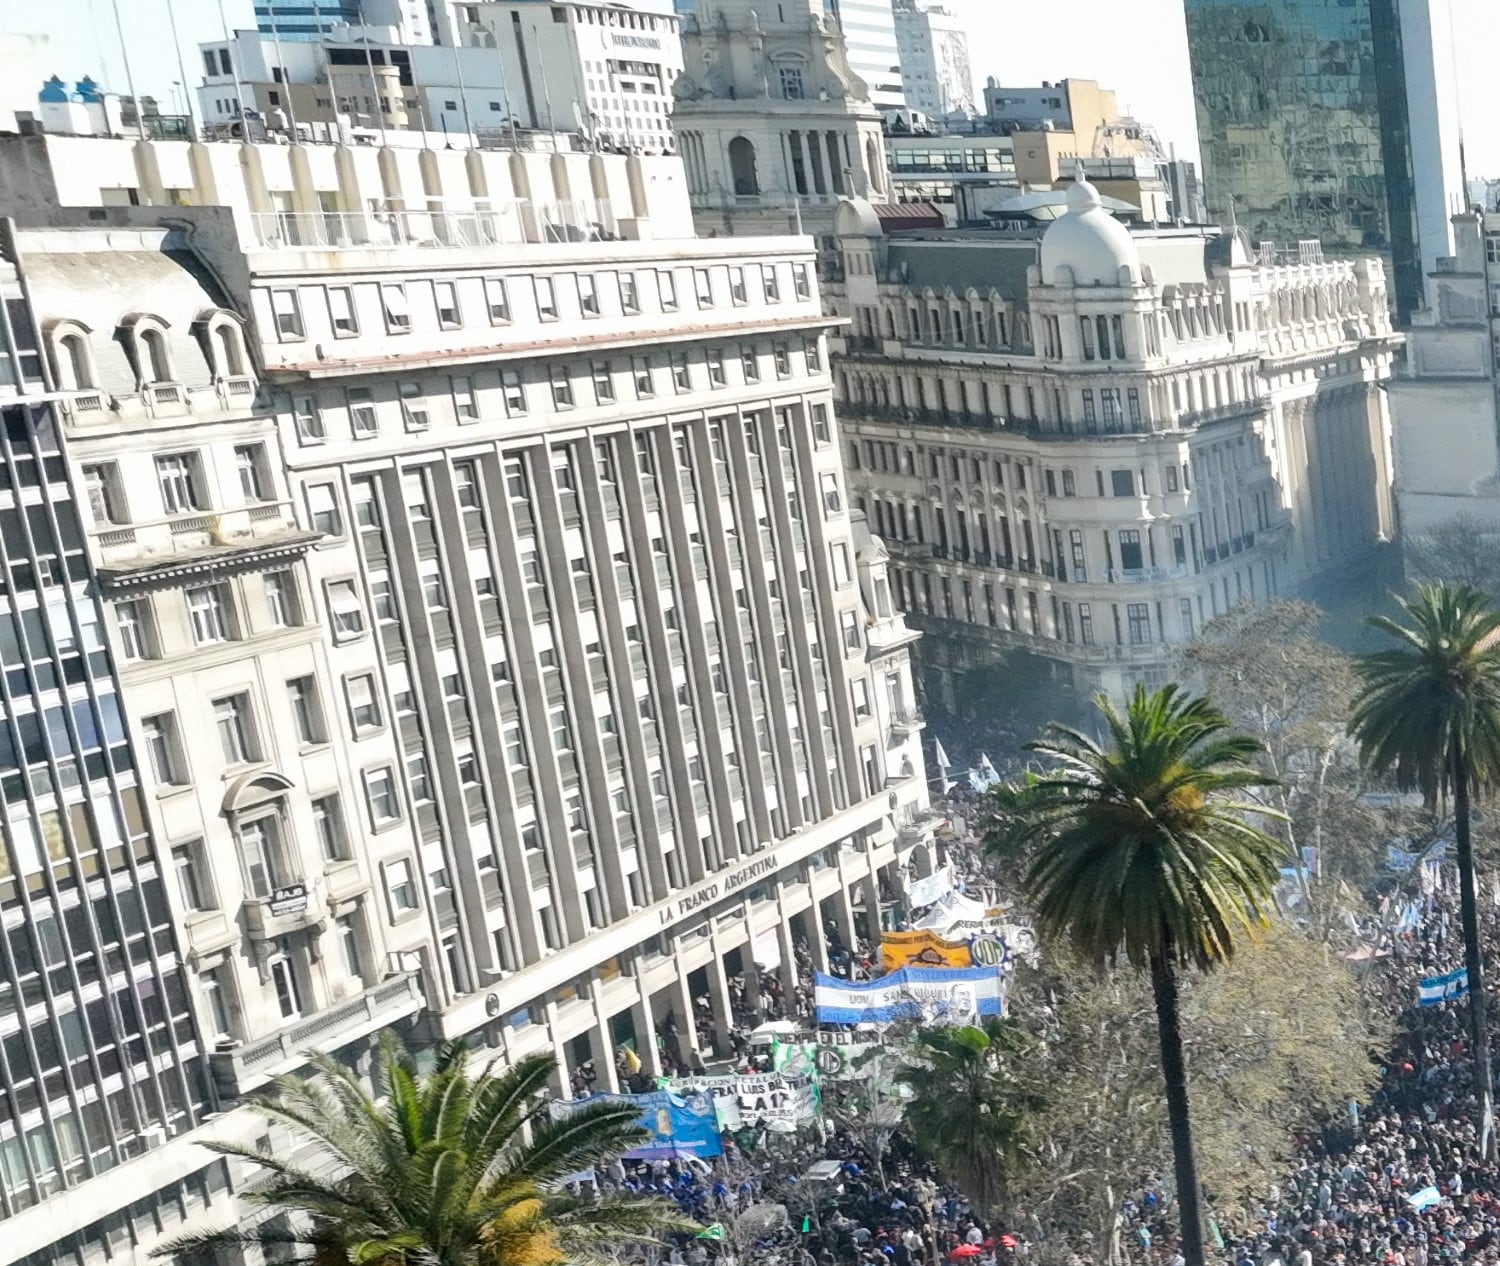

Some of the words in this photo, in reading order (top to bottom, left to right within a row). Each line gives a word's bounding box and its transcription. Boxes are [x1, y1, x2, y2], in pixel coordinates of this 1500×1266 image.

[659, 906, 674, 925] LA
[678, 884, 719, 916] FRANCO
[724, 854, 779, 893] ARGENTINA
